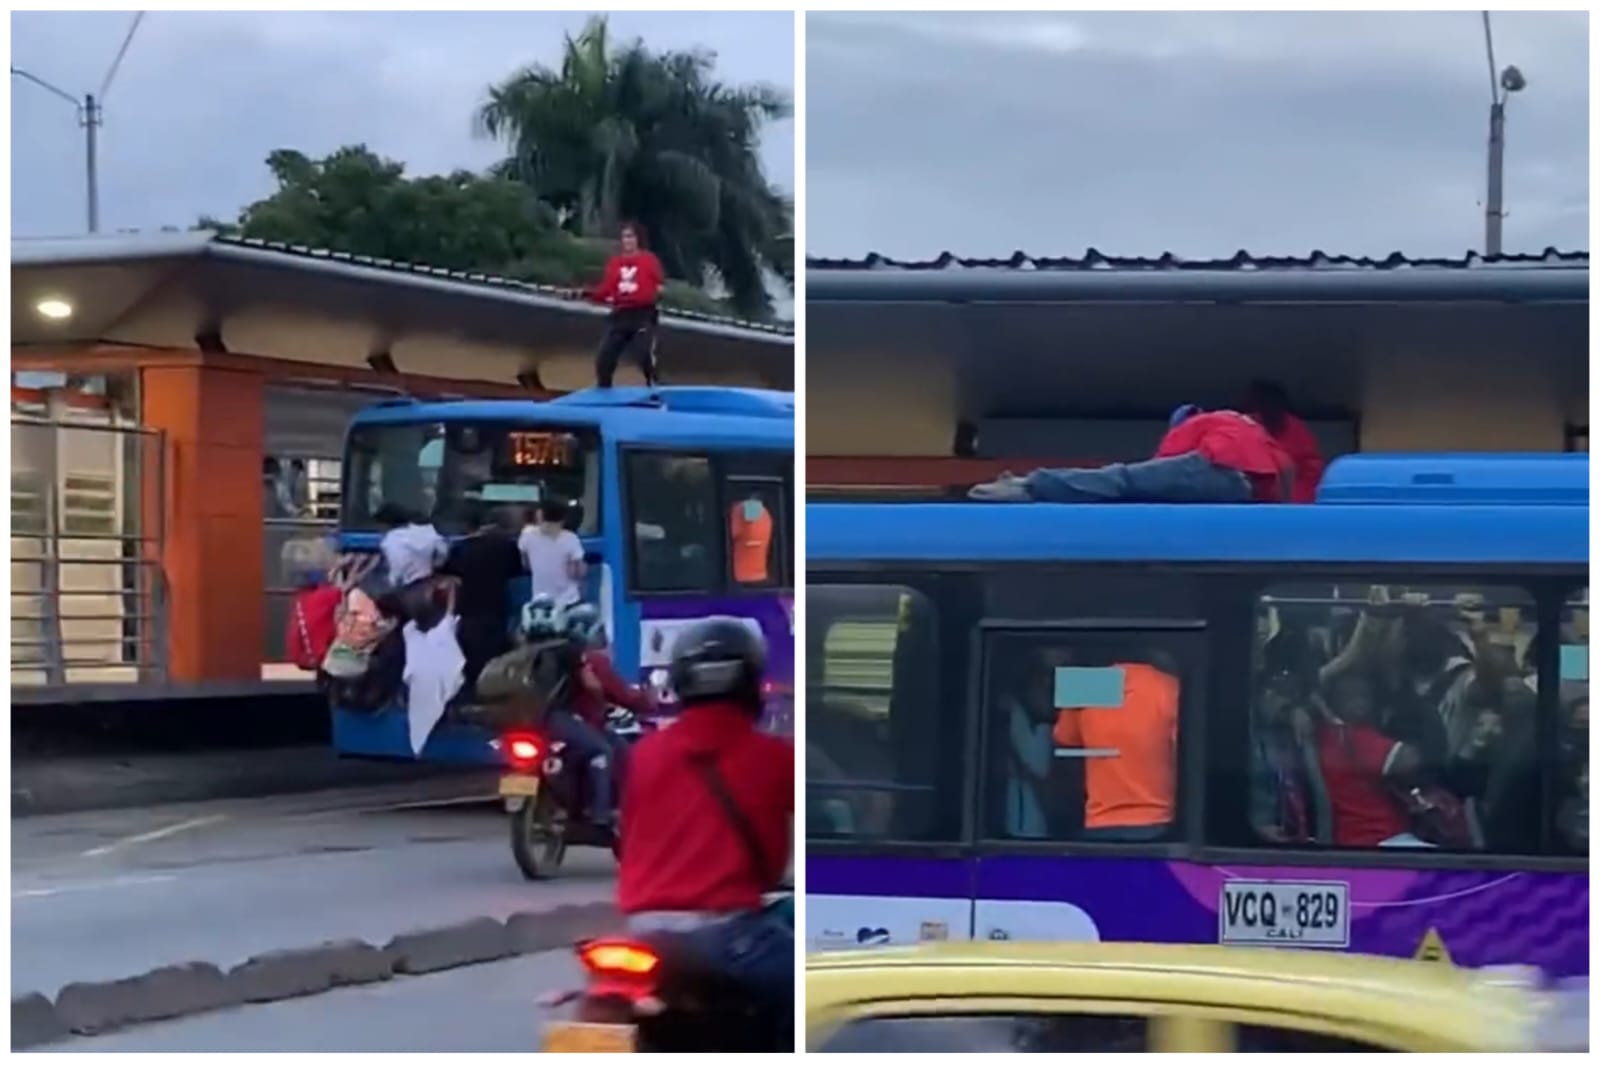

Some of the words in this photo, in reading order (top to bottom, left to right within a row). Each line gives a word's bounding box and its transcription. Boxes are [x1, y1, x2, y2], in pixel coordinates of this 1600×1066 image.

[1225, 891, 1277, 926] VCQ
[1296, 892, 1338, 928] 829
[1266, 928, 1303, 938] CALI
